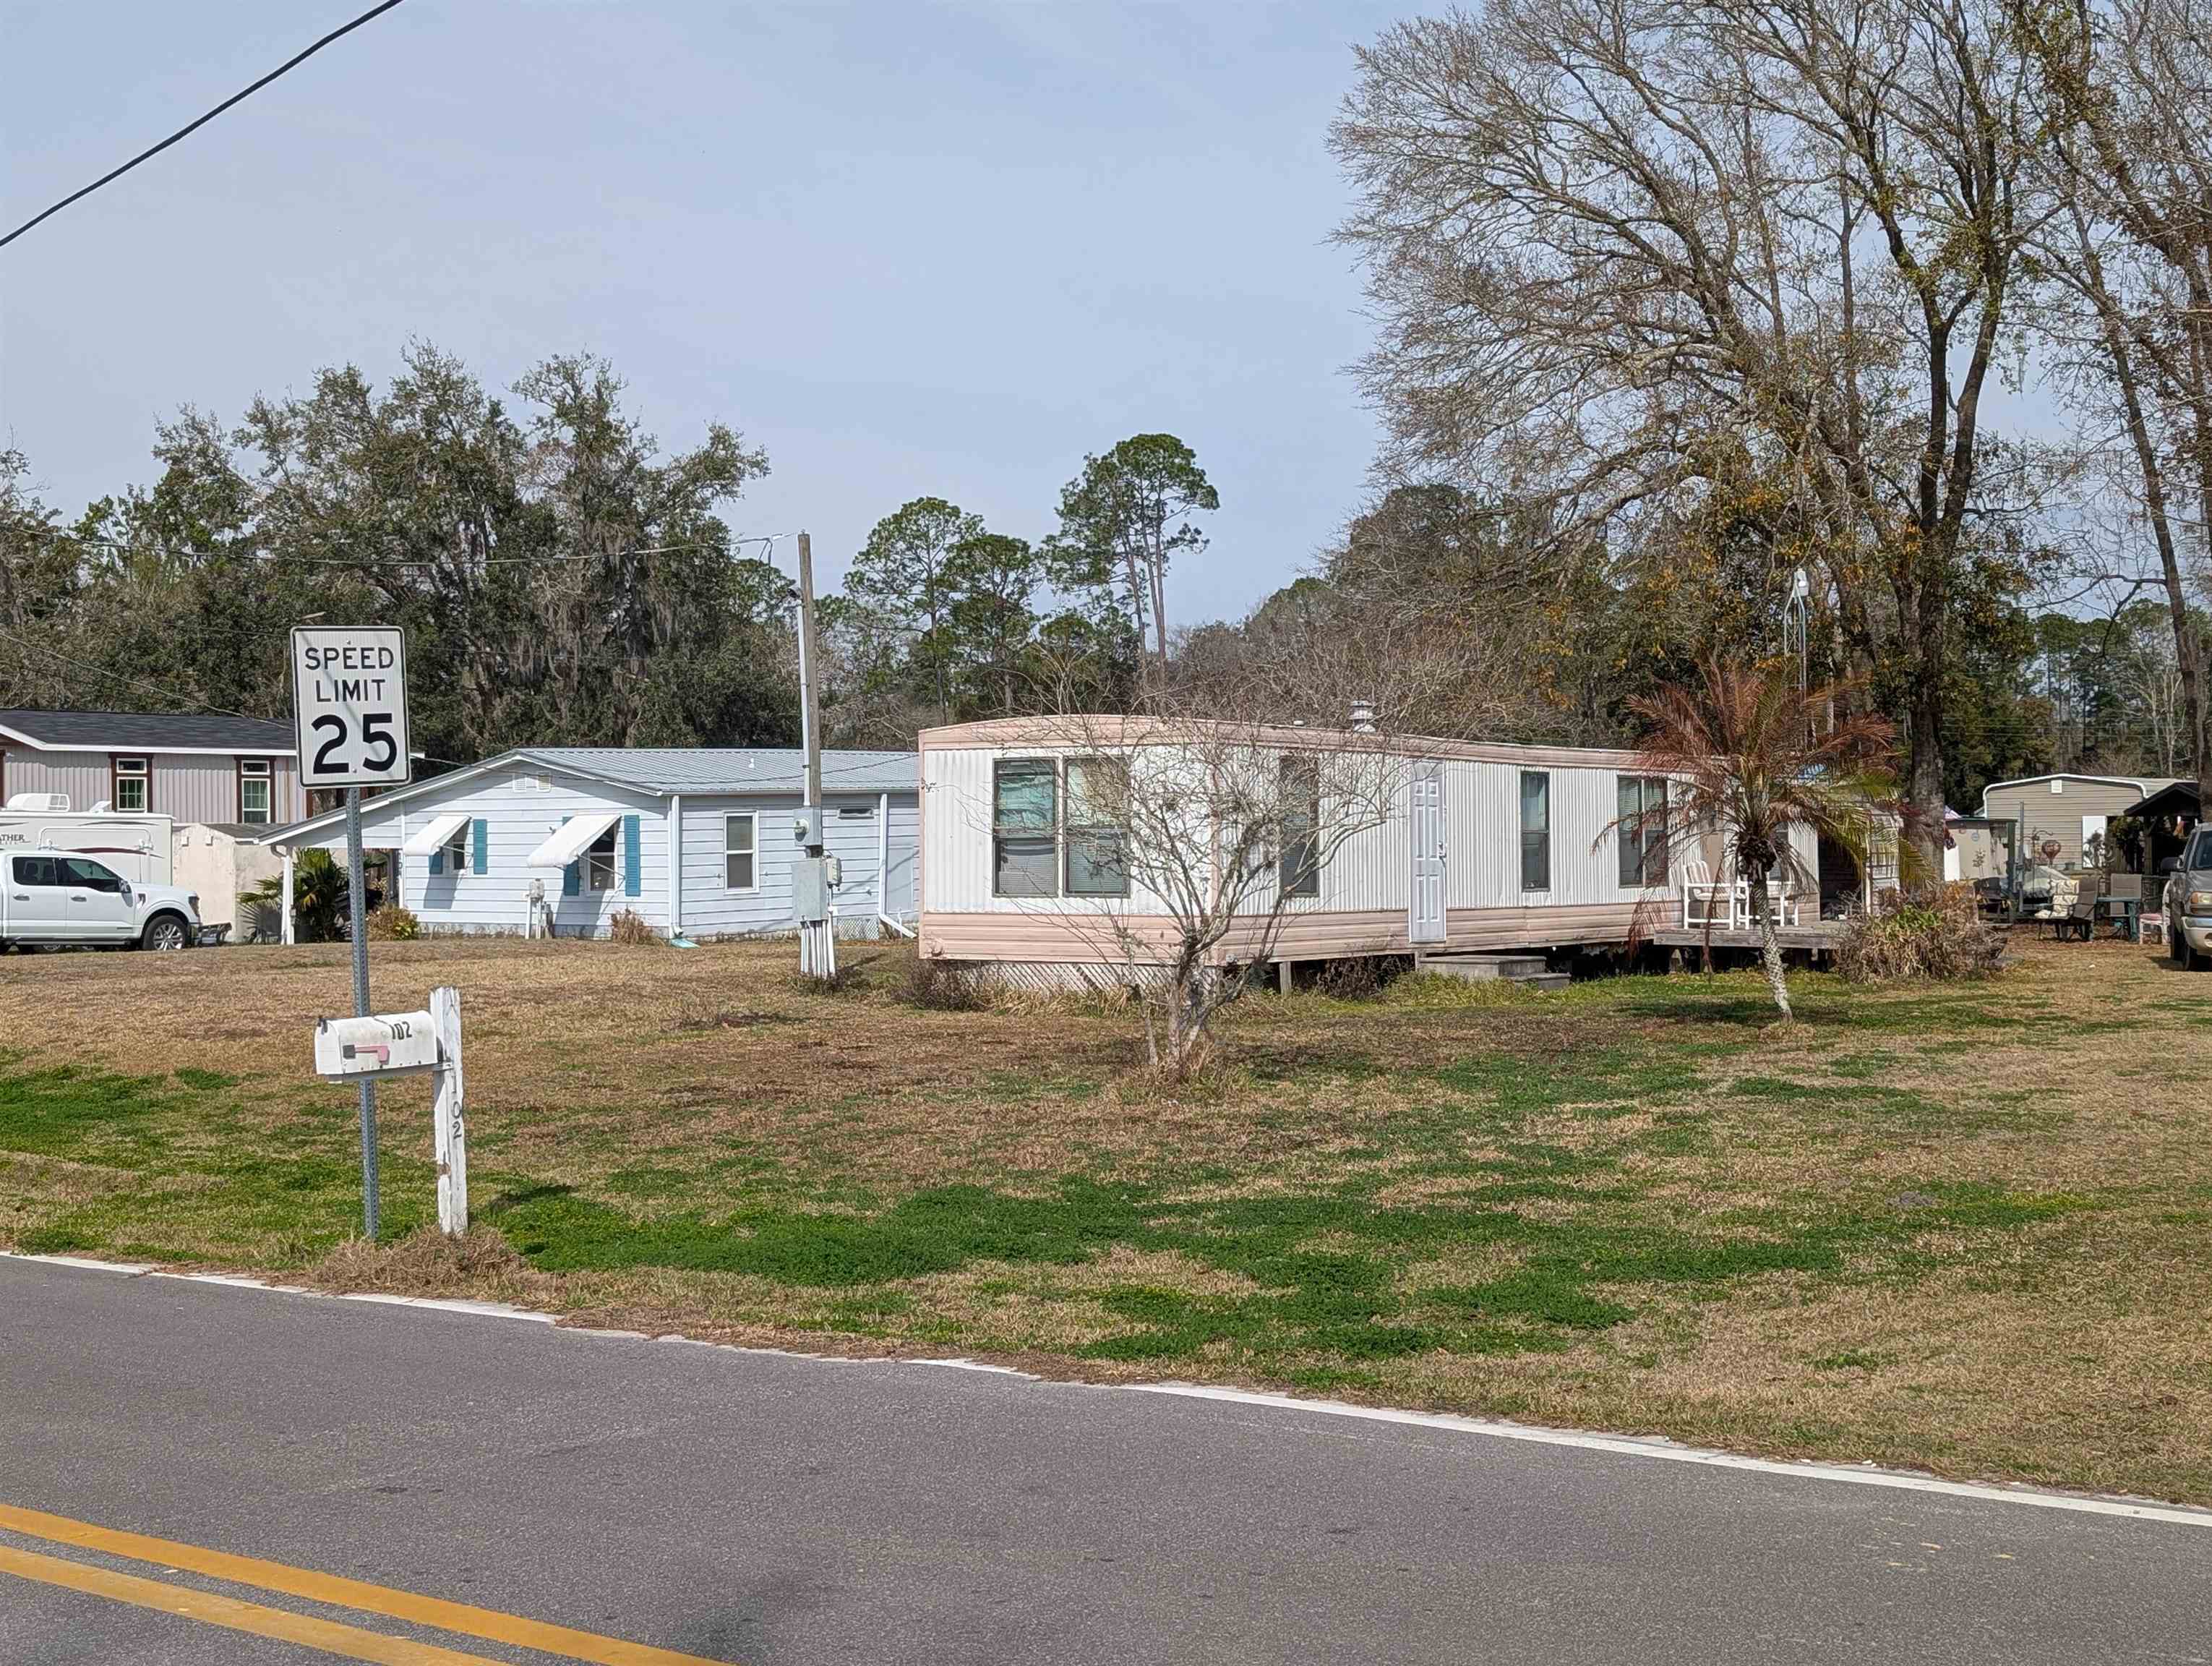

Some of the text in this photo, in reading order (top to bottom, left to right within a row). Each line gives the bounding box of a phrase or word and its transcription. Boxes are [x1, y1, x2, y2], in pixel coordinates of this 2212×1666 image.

[305, 646, 394, 670] SPEED
[315, 679, 385, 702] LIMIT
[311, 713, 398, 774] 25
[389, 1020, 413, 1040] 102
